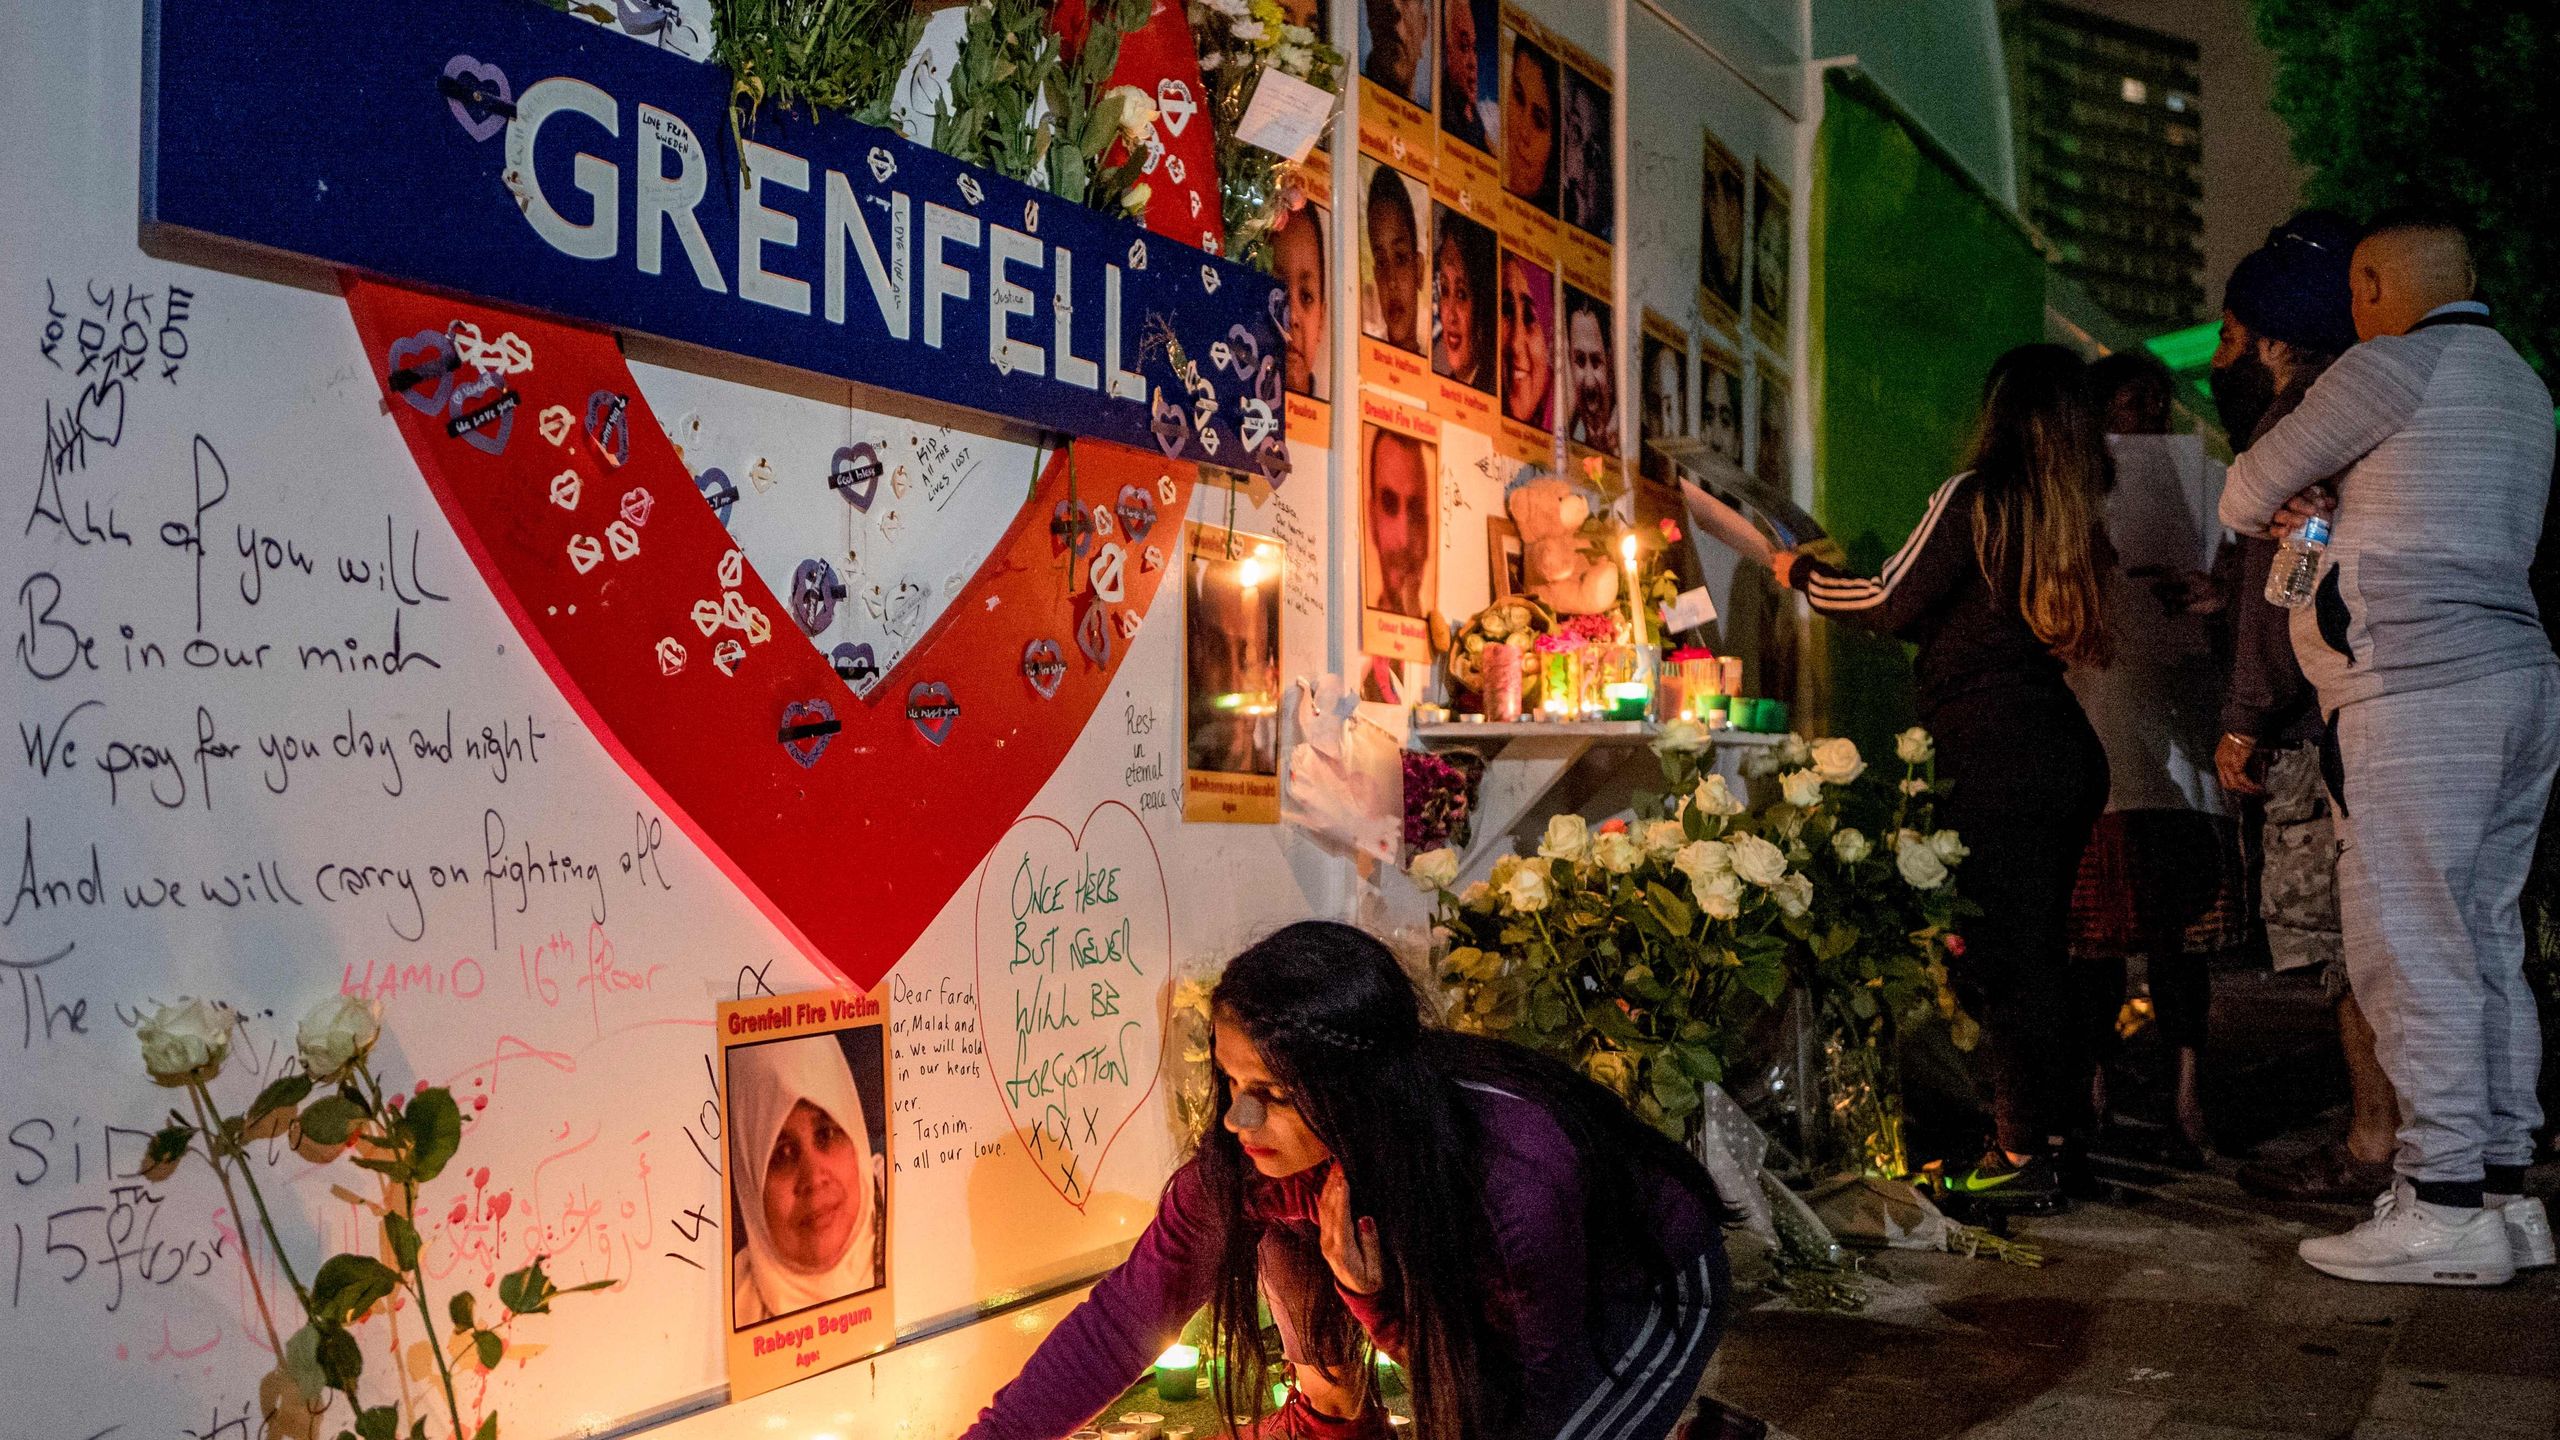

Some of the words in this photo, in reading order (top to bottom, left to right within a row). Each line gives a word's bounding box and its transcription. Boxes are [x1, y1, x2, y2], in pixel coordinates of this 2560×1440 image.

[642, 112, 662, 131] LOVE
[655, 132, 690, 154] SWEDEN
[504, 76, 1147, 403] GRENFELL
[992, 289, 1025, 306] Justice
[473, 410, 498, 429] Love
[160, 434, 230, 633] of
[238, 522, 314, 606] you
[339, 514, 450, 606] will
[16, 571, 100, 681] Be
[120, 625, 165, 674] in
[183, 640, 272, 671] our
[299, 607, 441, 672] mind
[1124, 704, 1157, 736] Rest
[18, 698, 105, 778] We
[96, 738, 187, 807] pray
[193, 705, 242, 810] for
[258, 730, 320, 793] you
[332, 708, 404, 796] day
[413, 708, 453, 765] and
[465, 713, 548, 784] night
[1125, 751, 1164, 788] eternal
[1133, 743, 1146, 759] in
[1139, 789, 1168, 821] peace
[3, 816, 106, 926] And
[124, 880, 187, 910] we
[200, 860, 304, 907] will
[315, 860, 427, 941] carry
[431, 863, 477, 890] on
[483, 808, 607, 951] fighting
[1012, 851, 1070, 922] ONCE
[1074, 852, 1122, 915] HERE
[1009, 920, 1060, 976] BUT
[1070, 917, 1144, 977] NEVER
[0, 941, 89, 1050] The
[580, 921, 669, 1037] floor
[893, 972, 933, 1005] Dear
[728, 1004, 793, 1036] Grenfell
[796, 1002, 827, 1027] Fire
[829, 995, 881, 1022] Victim
[1090, 979, 1121, 1021] BE
[911, 1013, 950, 1033] Malak
[954, 1017, 976, 1034] and
[909, 1043, 927, 1058] We
[933, 1038, 956, 1055] will
[961, 1037, 984, 1056] hold
[898, 1067, 911, 1083] in
[919, 1062, 940, 1077] our
[946, 1060, 981, 1080] hearts
[912, 1149, 931, 1170] all
[939, 1147, 963, 1165] our
[97, 1197, 226, 1313] floor
[752, 1322, 815, 1358] Rabeya
[816, 1305, 873, 1336] Begum
[794, 1349, 821, 1369] Age:
